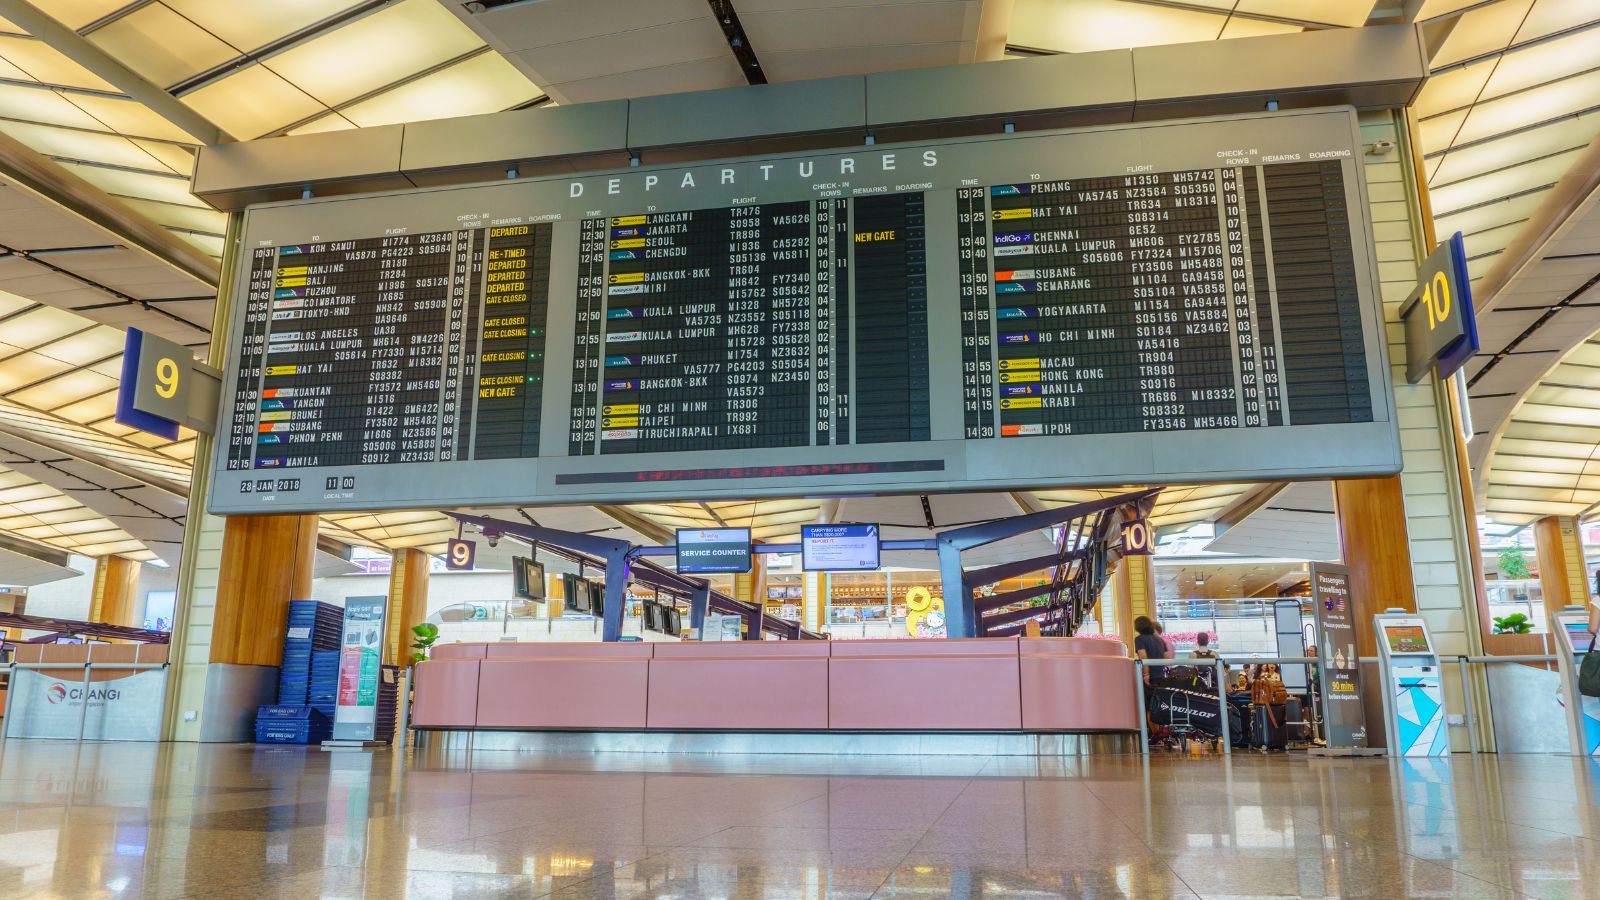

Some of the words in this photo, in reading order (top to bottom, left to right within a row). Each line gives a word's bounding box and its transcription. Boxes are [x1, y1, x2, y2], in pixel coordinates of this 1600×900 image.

[1262, 154, 1300, 162] REMARKS
[1310, 150, 1350, 159] BOARDING
[570, 150, 937, 198] DEPARTURES
[896, 182, 932, 191] BOARDING
[1030, 182, 1070, 193] PENANG
[1124, 174, 1158, 186] MI350
[853, 186, 887, 194] REMARKS
[646, 211, 692, 224] LANGKAWI
[731, 206, 760, 217] TR476
[1032, 207, 1050, 217] HAT
[1059, 205, 1077, 215] YAI
[491, 226, 528, 237] DEPARTED
[646, 223, 687, 235] JAKARTA
[645, 236, 674, 247] SEOUL
[855, 232, 872, 242] NEW
[874, 230, 893, 240] GATE
[994, 234, 1020, 243] IndiGo
[1033, 229, 1078, 242] CHENNAI
[310, 244, 325, 253] KOH
[330, 241, 355, 251] SAMUI
[645, 246, 686, 258] CHENGDU
[1034, 243, 1067, 254] KUALA
[1075, 239, 1115, 251] LUMPUR
[489, 248, 525, 259] RE-TIMED
[307, 263, 344, 274] NANJING
[488, 260, 526, 270] DEPARTED
[488, 271, 525, 281] DEPARTED
[644, 268, 709, 281] BANGKOK-BKK
[1035, 267, 1076, 279] SUBANG
[306, 276, 326, 285] BALI
[1036, 278, 1090, 291] SEMARANG
[305, 286, 336, 296] FUZHOU
[487, 282, 524, 292] DEPARTED
[643, 283, 666, 293] MIRI
[303, 295, 355, 307] COIMBATORE
[486, 295, 501, 303] GATE
[502, 294, 526, 302] CLOSED
[1422, 271, 1450, 330] 10
[303, 306, 350, 318] TOKYO-HND
[643, 306, 672, 317] KUALA
[679, 303, 715, 314] LUMPUR
[1038, 303, 1106, 316] YOGYAKARTA
[484, 318, 500, 326] GATE
[500, 317, 525, 325] CLOSED
[300, 331, 316, 340] LOS
[320, 328, 358, 339] ANGELES
[484, 330, 499, 338] GATE
[500, 328, 526, 337] CLOSING
[642, 330, 672, 340] KUALA
[678, 327, 714, 338] LUMPUR
[1038, 332, 1052, 342] HO
[1059, 330, 1078, 341] CHI
[1087, 328, 1114, 339] MINH
[1186, 322, 1228, 334] NZ3462
[298, 342, 325, 351] KUALA
[330, 338, 362, 349] LUMPUR
[482, 353, 498, 362] GATE
[498, 352, 524, 360] CLOSING
[641, 353, 676, 364] PHUKET
[1040, 356, 1074, 368] MACAU
[1140, 351, 1173, 362] TR904
[296, 365, 311, 374] HAT
[317, 363, 332, 372] YAI
[1040, 370, 1068, 381] HONG
[1075, 368, 1103, 379] KONG
[156, 358, 178, 398] 9
[480, 377, 496, 385] GATE
[497, 375, 523, 384] CLOSING
[640, 376, 707, 389] BANGKOK-BKK
[293, 386, 331, 396] KUANTAN
[479, 388, 495, 397] NEW
[496, 387, 515, 396] GATE
[727, 385, 764, 397] VA5573
[1041, 382, 1083, 394] MANILA
[292, 398, 324, 408] YANGON
[639, 404, 650, 414] HO
[658, 403, 674, 413] CHI
[682, 401, 707, 412] MINH
[727, 398, 757, 409] TR306
[1042, 396, 1075, 407] KRABI
[291, 409, 322, 420] BRUNEI
[639, 415, 673, 426] TAIPEI
[290, 421, 322, 431] SUBANG
[638, 426, 717, 438] TIRUCHIRAPALI
[1045, 423, 1071, 434] IPOH
[1143, 418, 1186, 429] FY3546
[288, 433, 315, 442] PHNOM
[320, 431, 342, 441] PENH
[285, 456, 318, 466] MANILA
[400, 451, 434, 461] NZ3438
[1122, 524, 1146, 550] 10
[452, 543, 469, 566] 9
[1320, 576, 1344, 585] Passengers
[1319, 586, 1342, 595] travelling
[1332, 682, 1340, 690] 90
[1341, 682, 1354, 690] mins
[1169, 706, 1216, 718] DUNLOP
